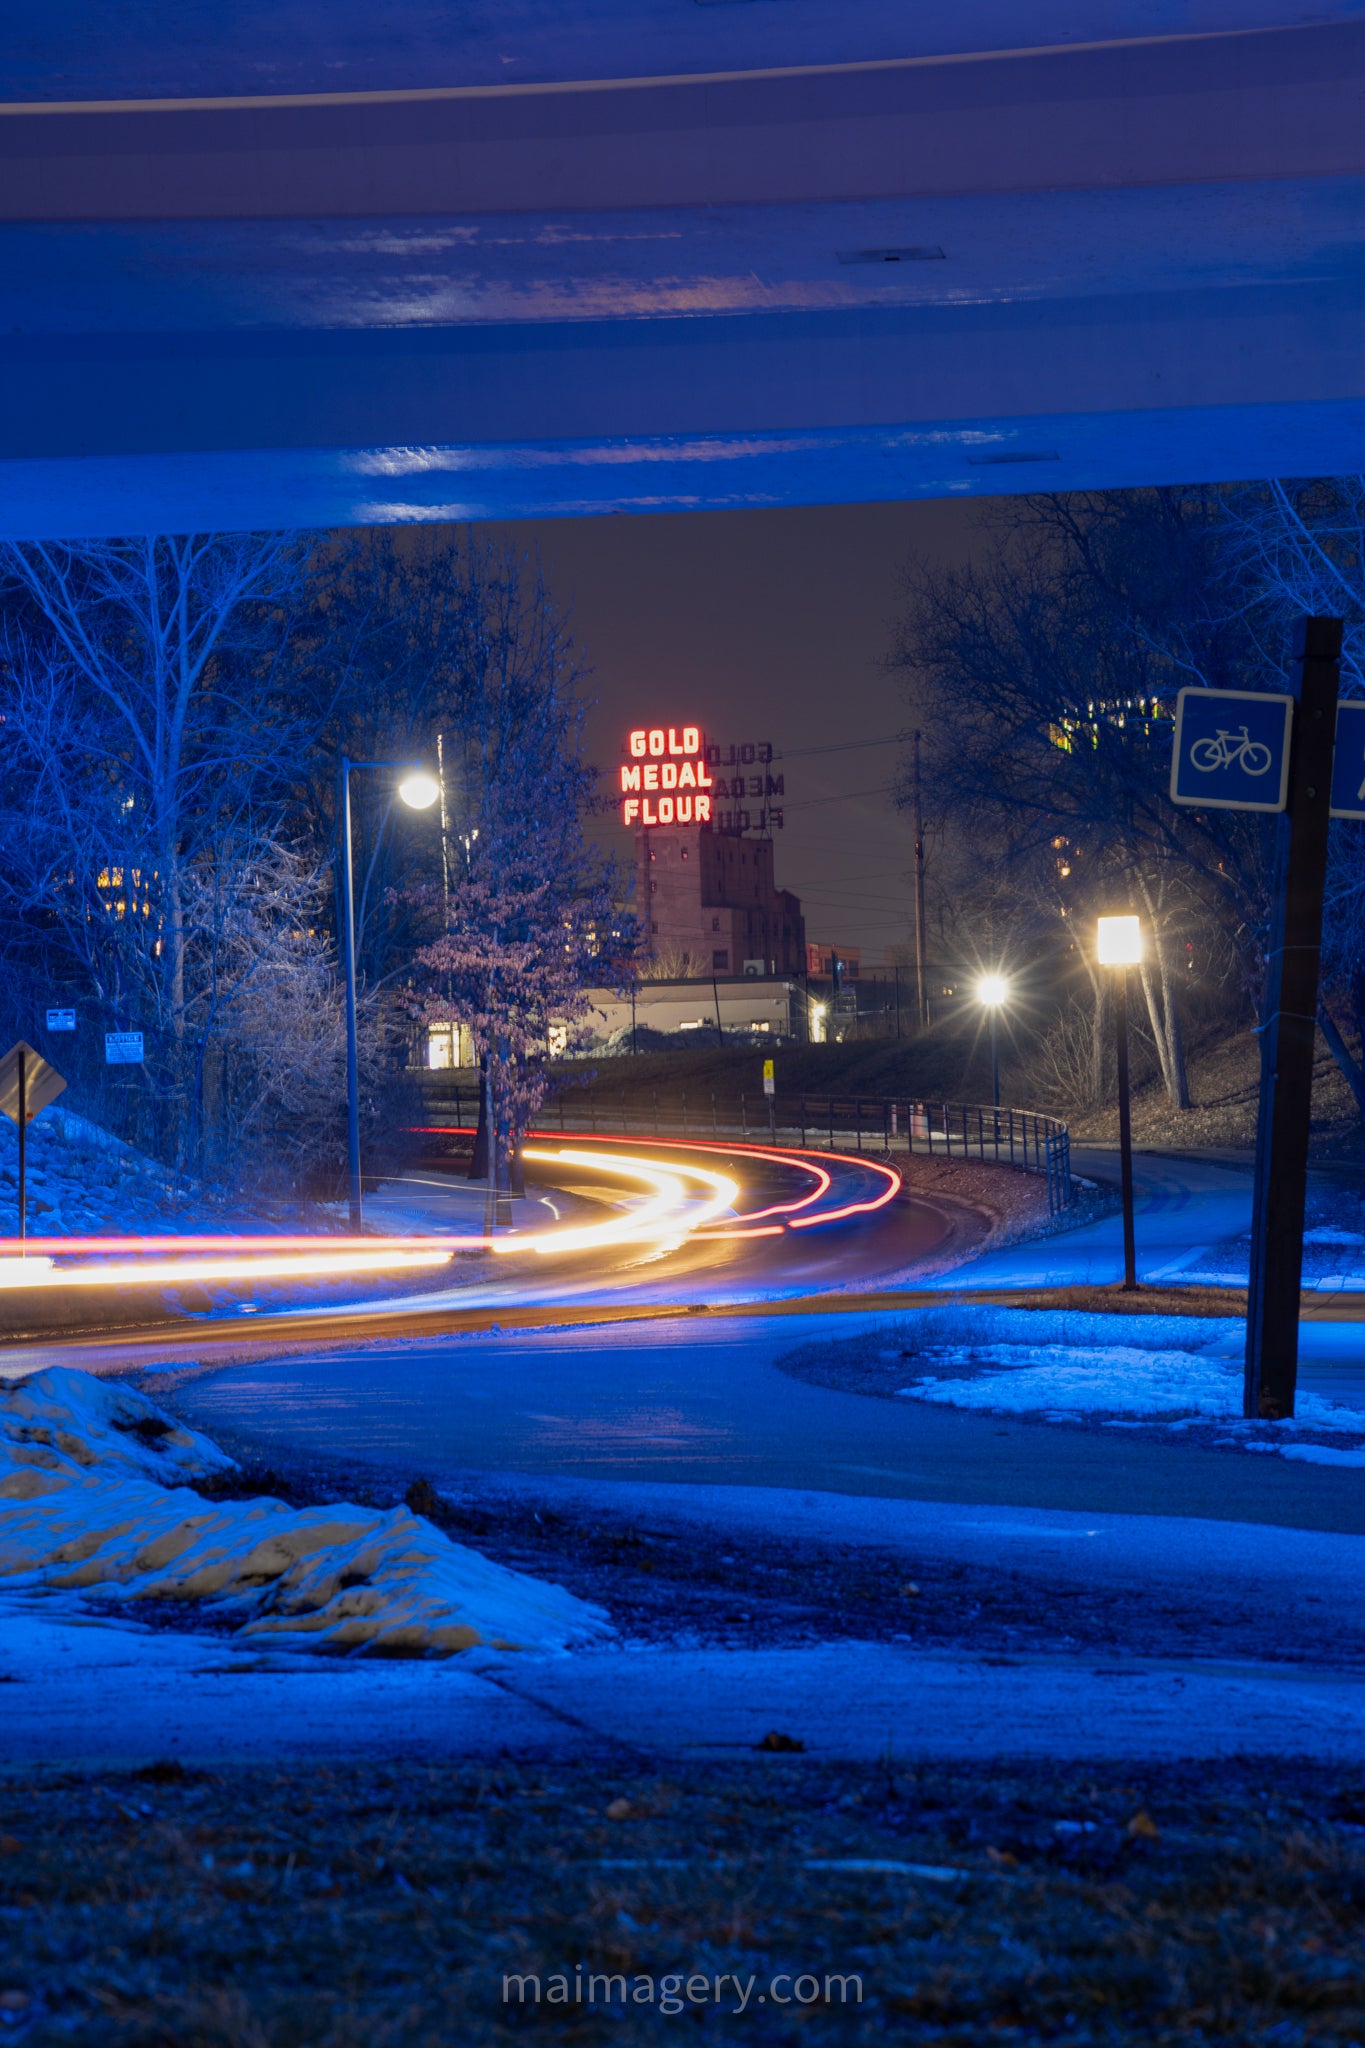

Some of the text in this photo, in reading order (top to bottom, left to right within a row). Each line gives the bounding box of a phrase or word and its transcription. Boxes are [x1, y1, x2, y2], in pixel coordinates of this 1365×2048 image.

[630, 727, 699, 757] GOLD
[621, 761, 712, 792] MEDAL
[624, 795, 710, 825] FLOUR
[109, 1035, 139, 1043] NOTICE
